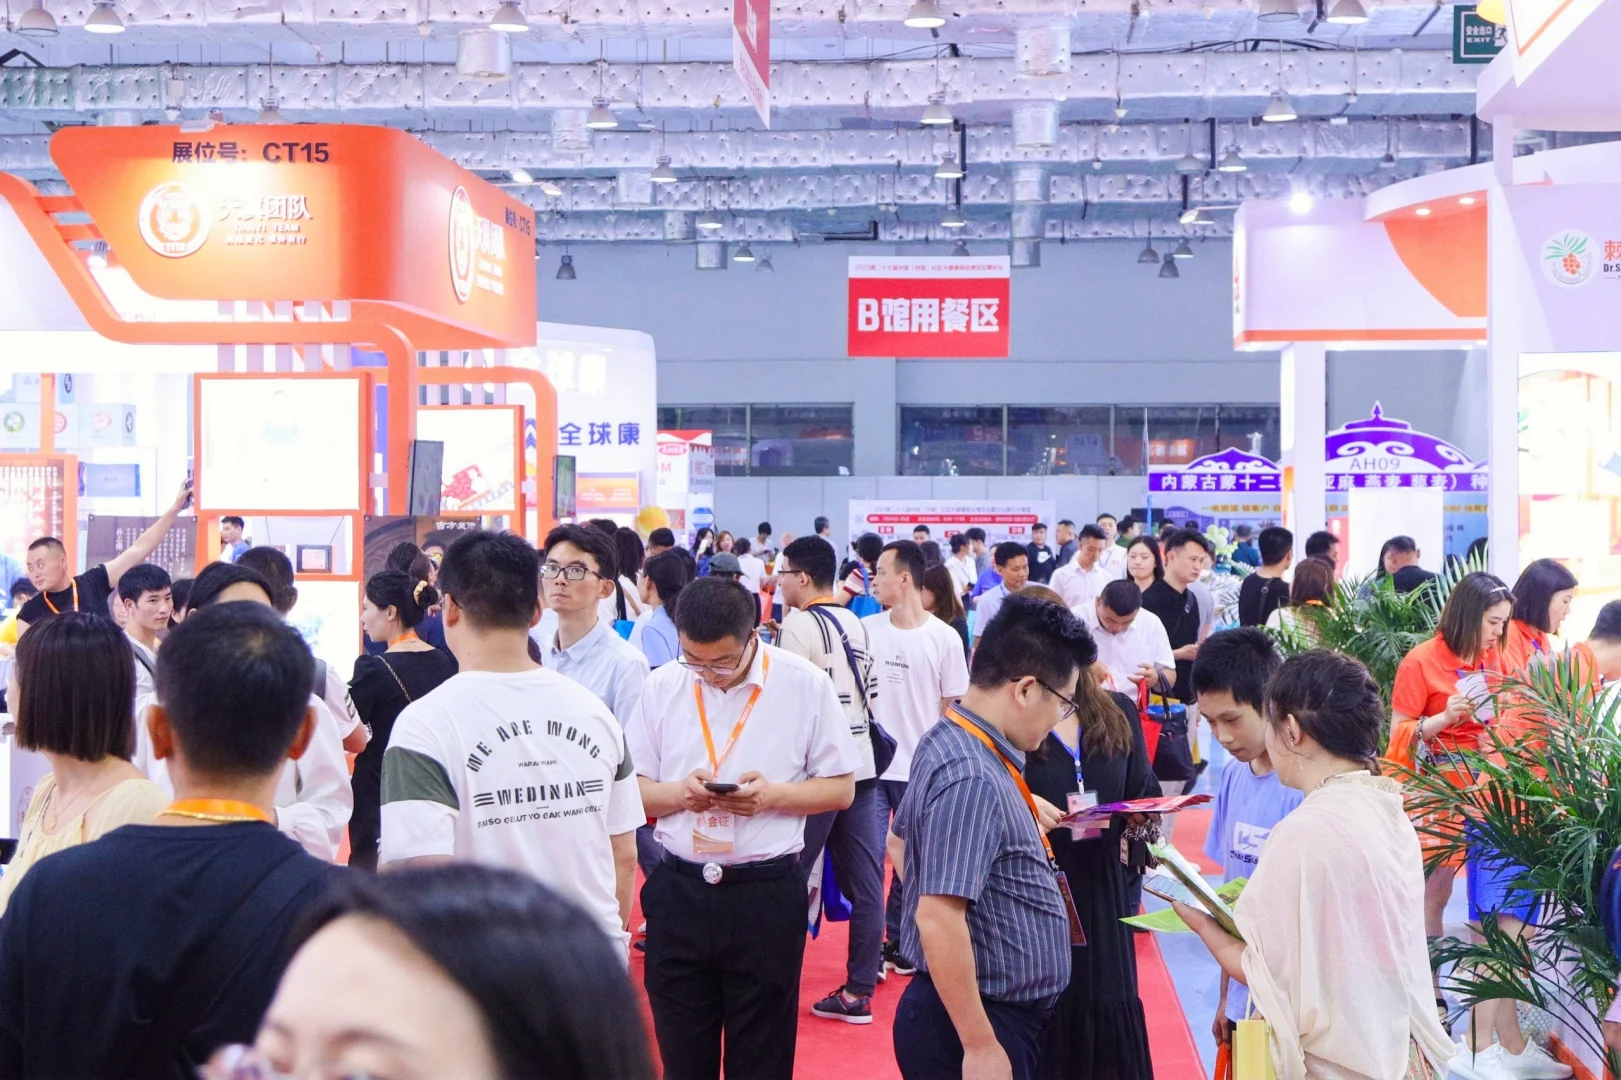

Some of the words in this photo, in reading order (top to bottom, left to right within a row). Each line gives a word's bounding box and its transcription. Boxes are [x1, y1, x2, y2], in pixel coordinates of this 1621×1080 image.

[1465, 25, 1492, 36] 安全出口
[262, 142, 330, 163] CT15
[857, 297, 1000, 333] B馆用餐区
[558, 422, 641, 446] 全球康
[1350, 457, 1400, 470] AH09
[1162, 474, 1283, 491] 内蒙古蒙十二
[885, 660, 910, 669] ROMON
[466, 741, 493, 773] WE
[496, 719, 533, 743] ARE
[547, 719, 601, 759] WONG
[496, 780, 586, 806] WEDINAN
[528, 809, 541, 820] YO
[543, 811, 561, 819] GAK
[584, 804, 604, 813] GELU
